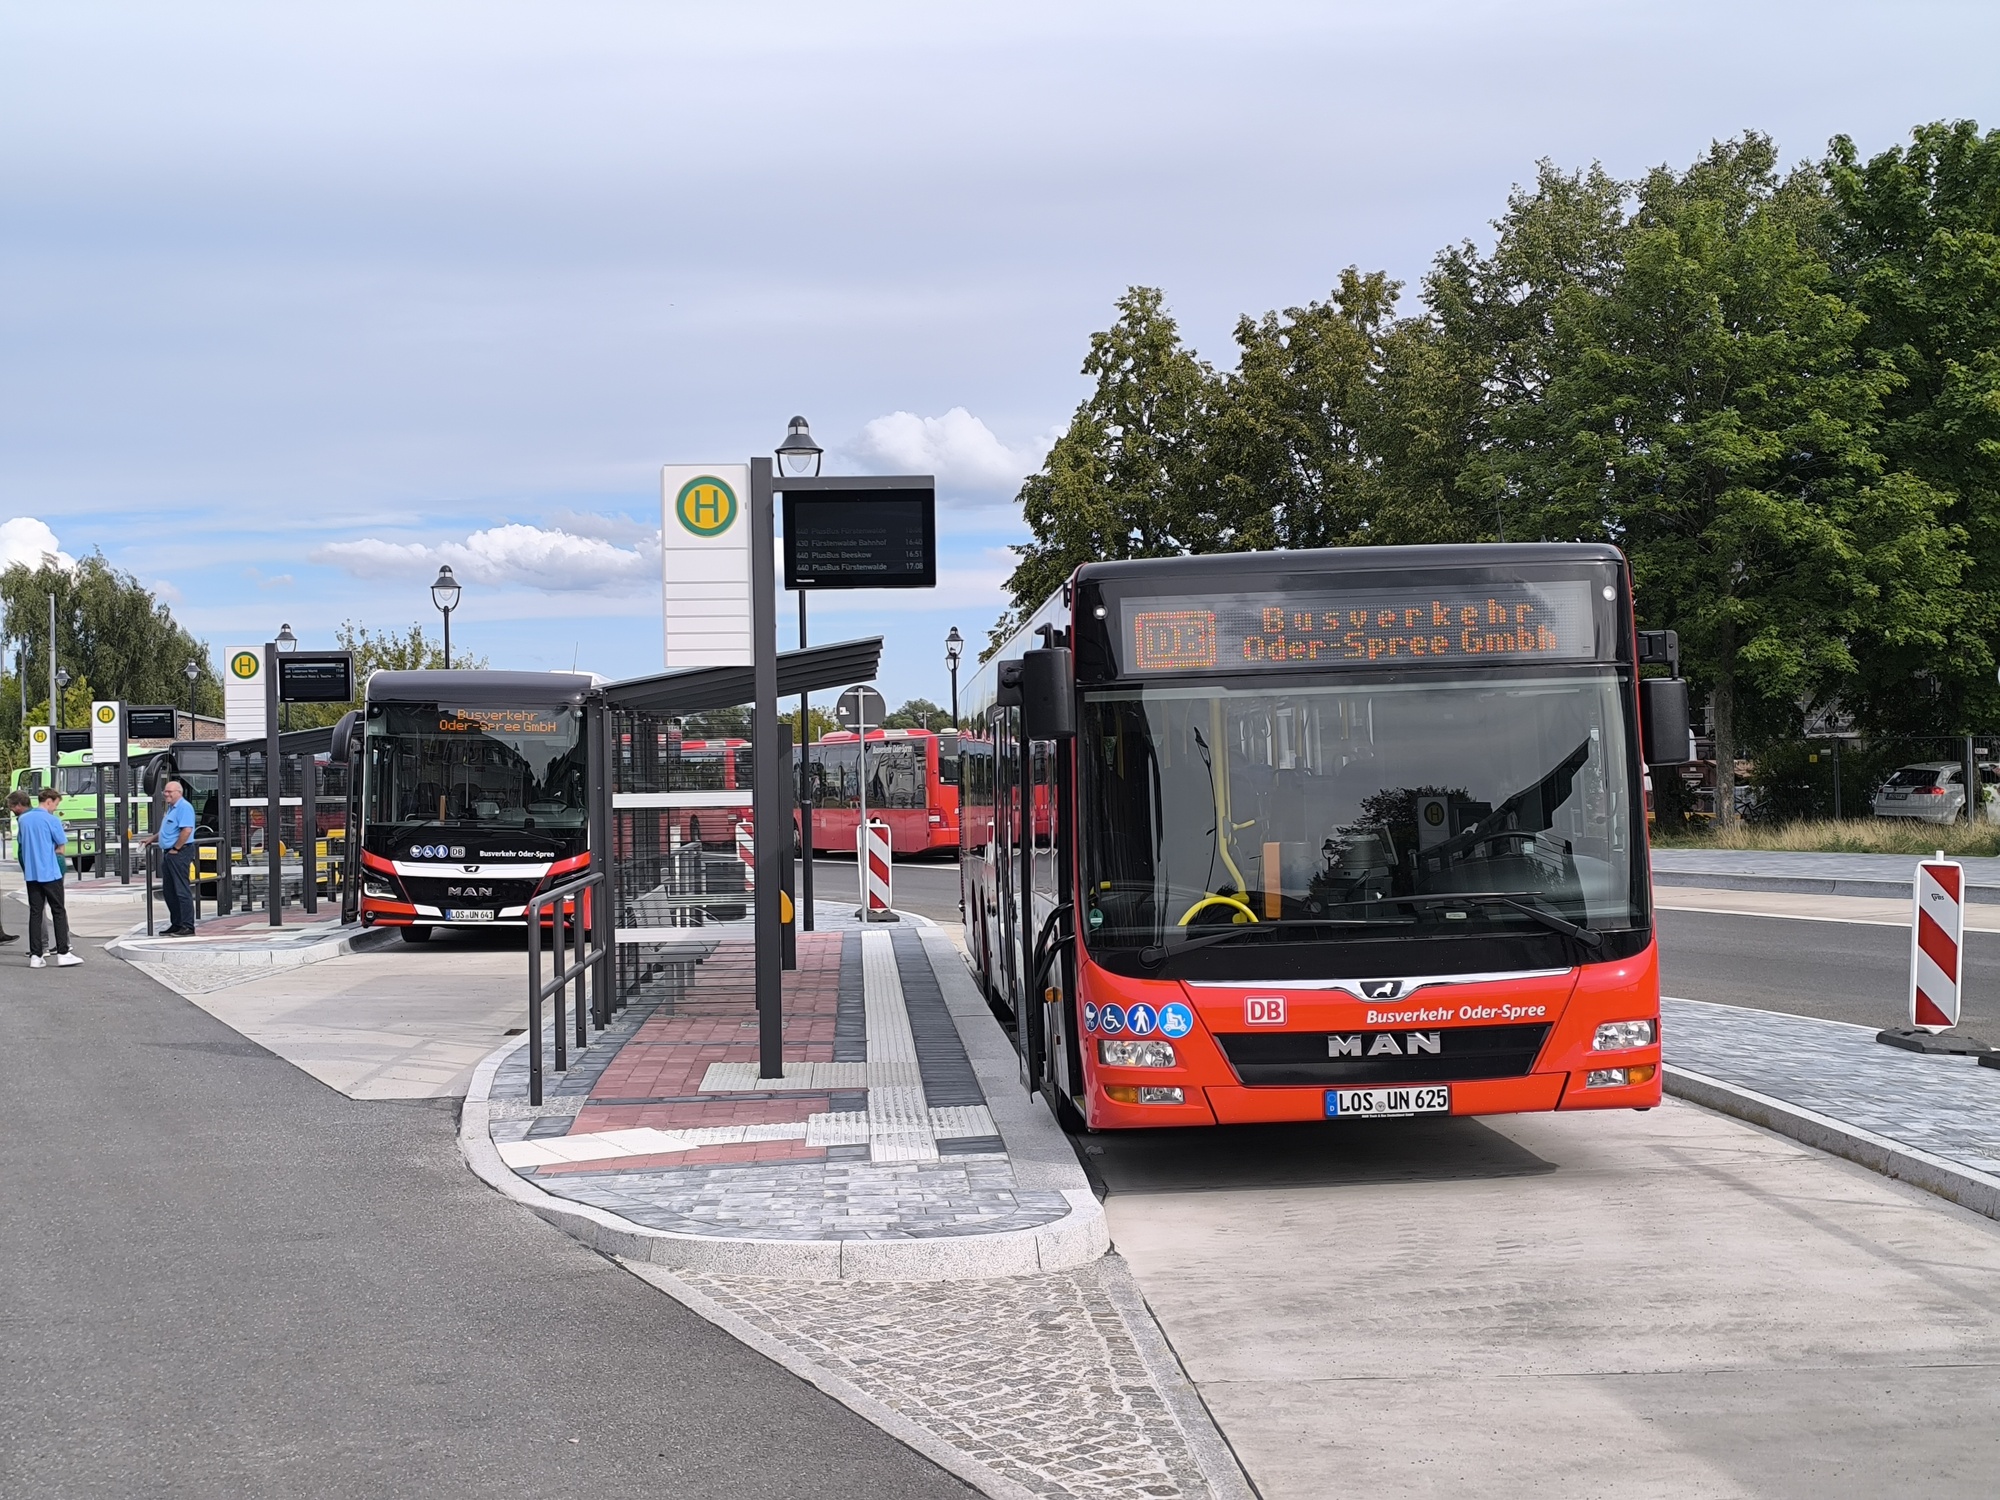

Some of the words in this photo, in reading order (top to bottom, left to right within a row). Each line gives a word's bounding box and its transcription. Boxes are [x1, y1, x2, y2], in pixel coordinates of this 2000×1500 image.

[695, 490, 719, 523] H
[811, 551, 840, 559] PlusBus
[812, 563, 840, 571] PlusBus
[841, 563, 888, 571] Fürstenwalde
[1262, 598, 1534, 633] Busverkehr
[1243, 631, 1450, 661] Oder-Spree
[239, 658, 251, 673] H
[457, 709, 539, 721] Busverkehr
[440, 719, 521, 732] Oder-Spree
[523, 721, 557, 732] GmbH
[452, 848, 463, 856] DB
[479, 850, 517, 858] Busverkehr
[518, 850, 555, 859] Oder-Spree
[448, 886, 493, 897] MAN
[451, 911, 465, 919] LOS
[480, 911, 493, 919] 641
[1251, 1001, 1281, 1020] DB
[1366, 1007, 1455, 1024] Busverkehr
[1459, 1003, 1546, 1021] Oder-Spree
[1328, 1030, 1441, 1058] MAN
[1339, 1092, 1373, 1112] LOS
[1387, 1091, 1410, 1110] UN
[1415, 1089, 1447, 1109] 625
